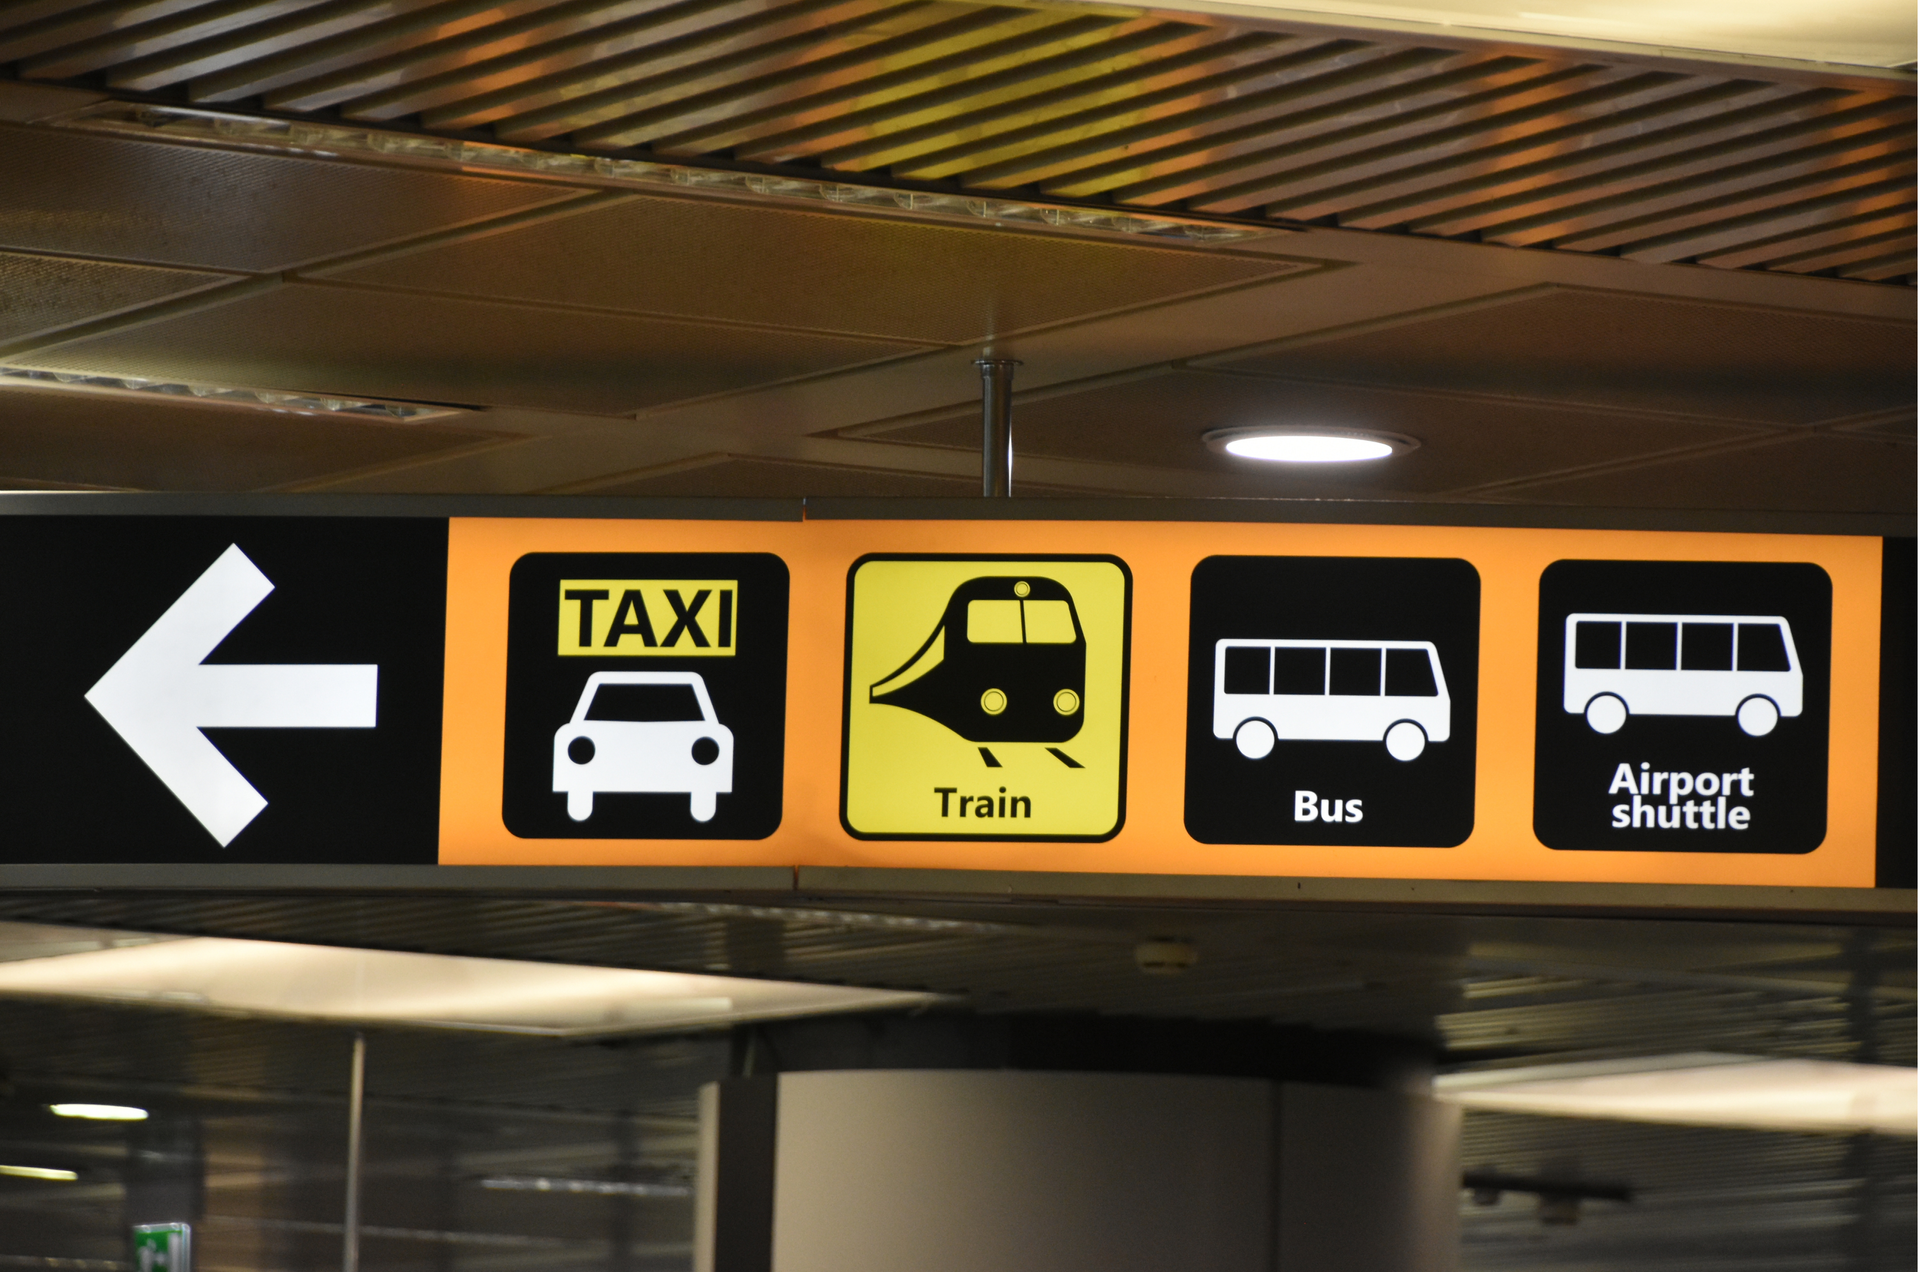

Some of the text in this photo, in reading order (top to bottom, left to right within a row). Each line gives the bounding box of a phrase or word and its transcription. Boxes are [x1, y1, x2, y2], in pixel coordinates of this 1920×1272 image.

[564, 588, 734, 648] TAXI
[1608, 761, 1755, 804] Airport
[934, 786, 1032, 818] Train
[1294, 790, 1364, 823] Bus
[1612, 795, 1751, 830] shuttle
